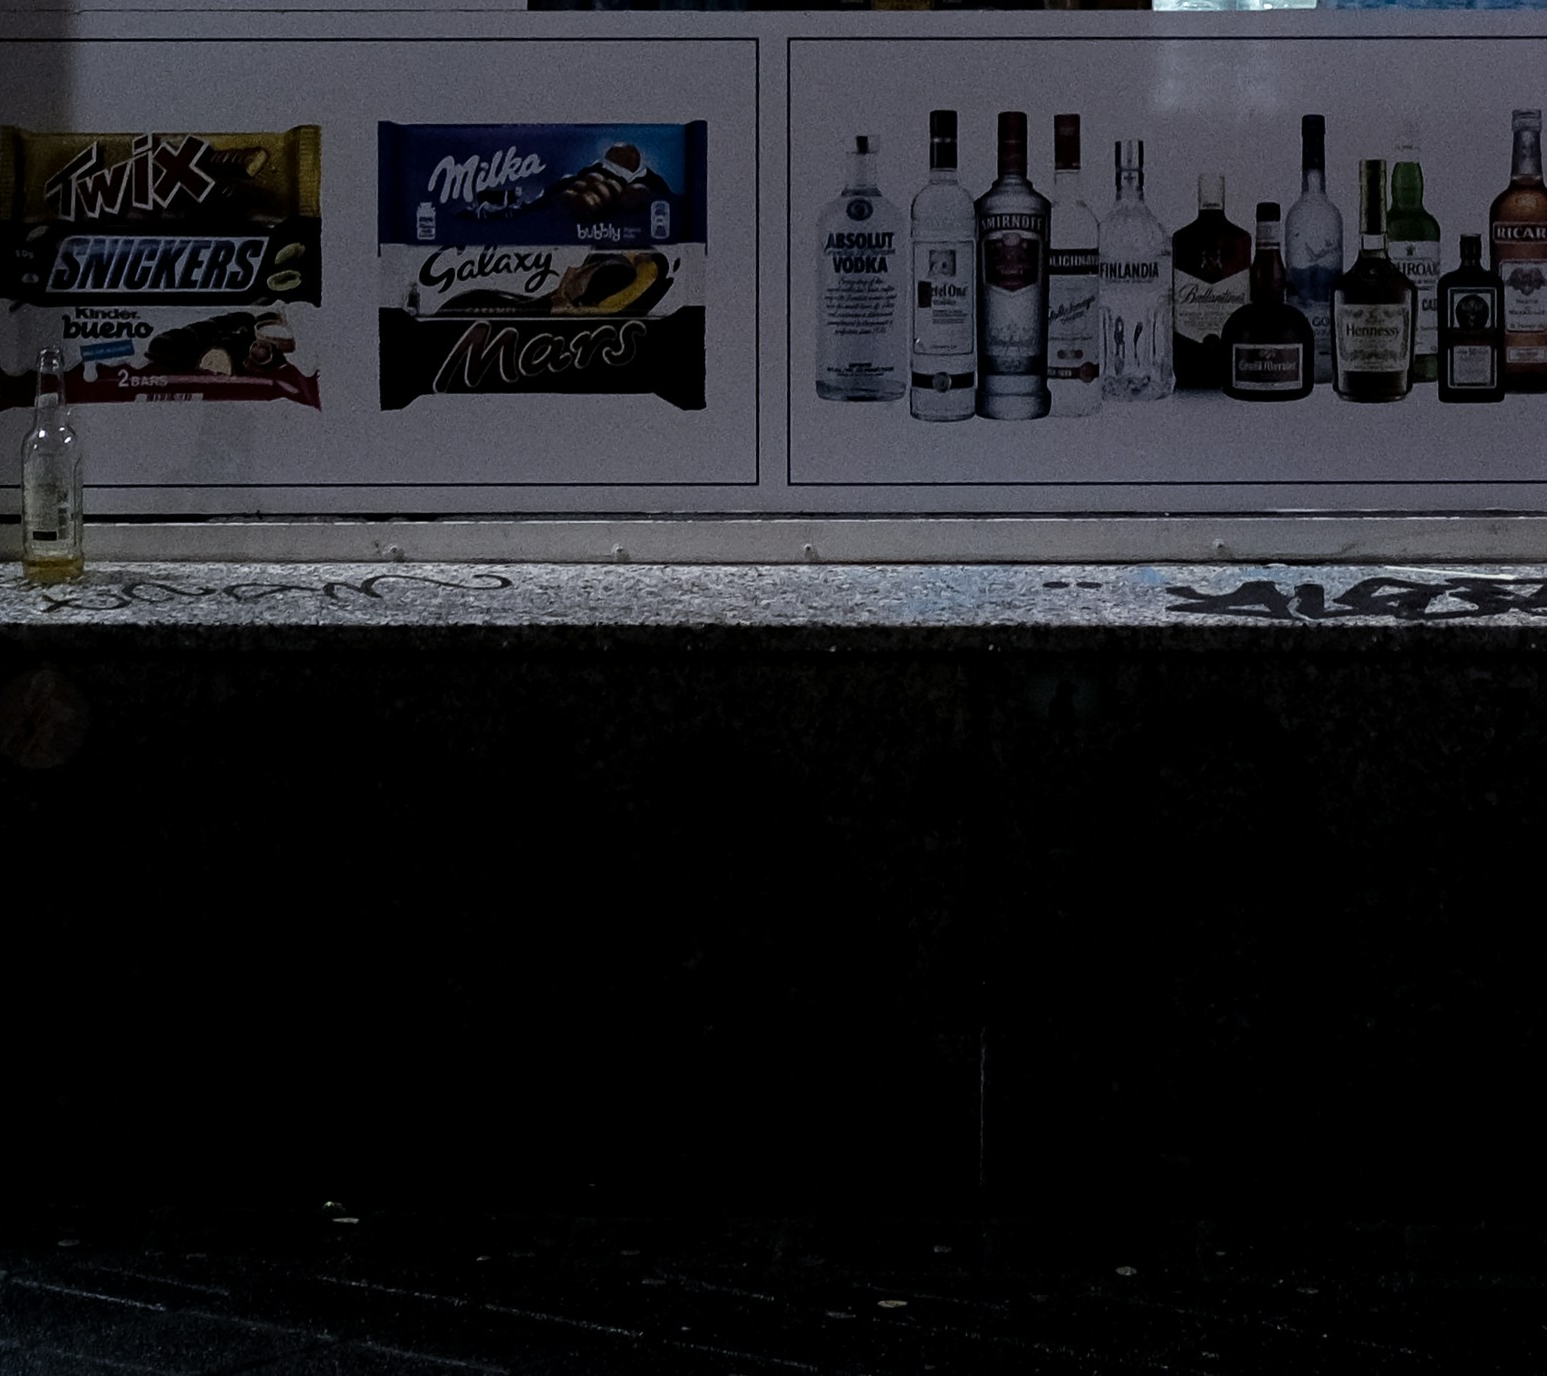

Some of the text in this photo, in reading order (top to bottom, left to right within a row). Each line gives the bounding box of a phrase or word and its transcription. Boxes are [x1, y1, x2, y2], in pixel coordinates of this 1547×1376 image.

[427, 145, 548, 205] Milka
[980, 214, 1045, 231] SMIRNOFF
[825, 232, 895, 249] ABSOLUT
[51, 236, 261, 293] SNICKERS
[419, 244, 560, 293] Galaxy
[832, 255, 889, 274] VODKA
[1100, 262, 1160, 280] FINLANDIA
[62, 315, 154, 339] bueno
[1345, 323, 1400, 342] Hennessy
[432, 319, 648, 394] Mars
